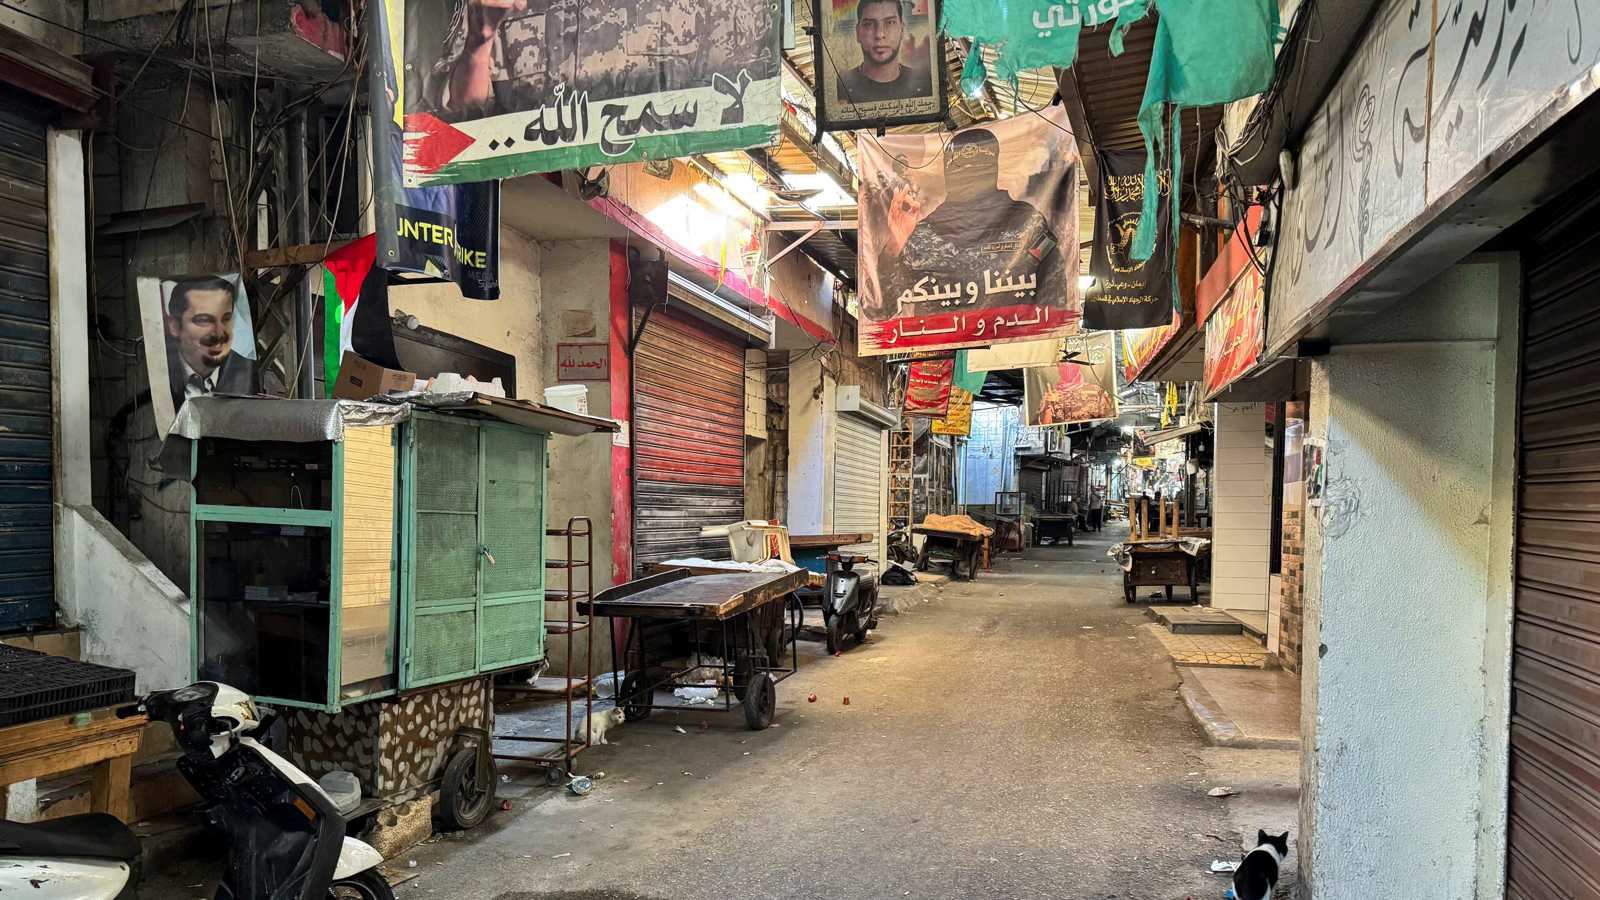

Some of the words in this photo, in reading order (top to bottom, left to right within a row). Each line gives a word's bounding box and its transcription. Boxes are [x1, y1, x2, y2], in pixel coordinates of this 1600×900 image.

[1033, 0, 1134, 37] ورتي
[712, 68, 752, 125] لا
[600, 97, 698, 157] سمح
[984, 270, 1037, 298] بيننا
[889, 314, 966, 344] النار
[972, 319, 985, 336] و
[993, 306, 1049, 335] الدم
[577, 357, 607, 369] الحمد
